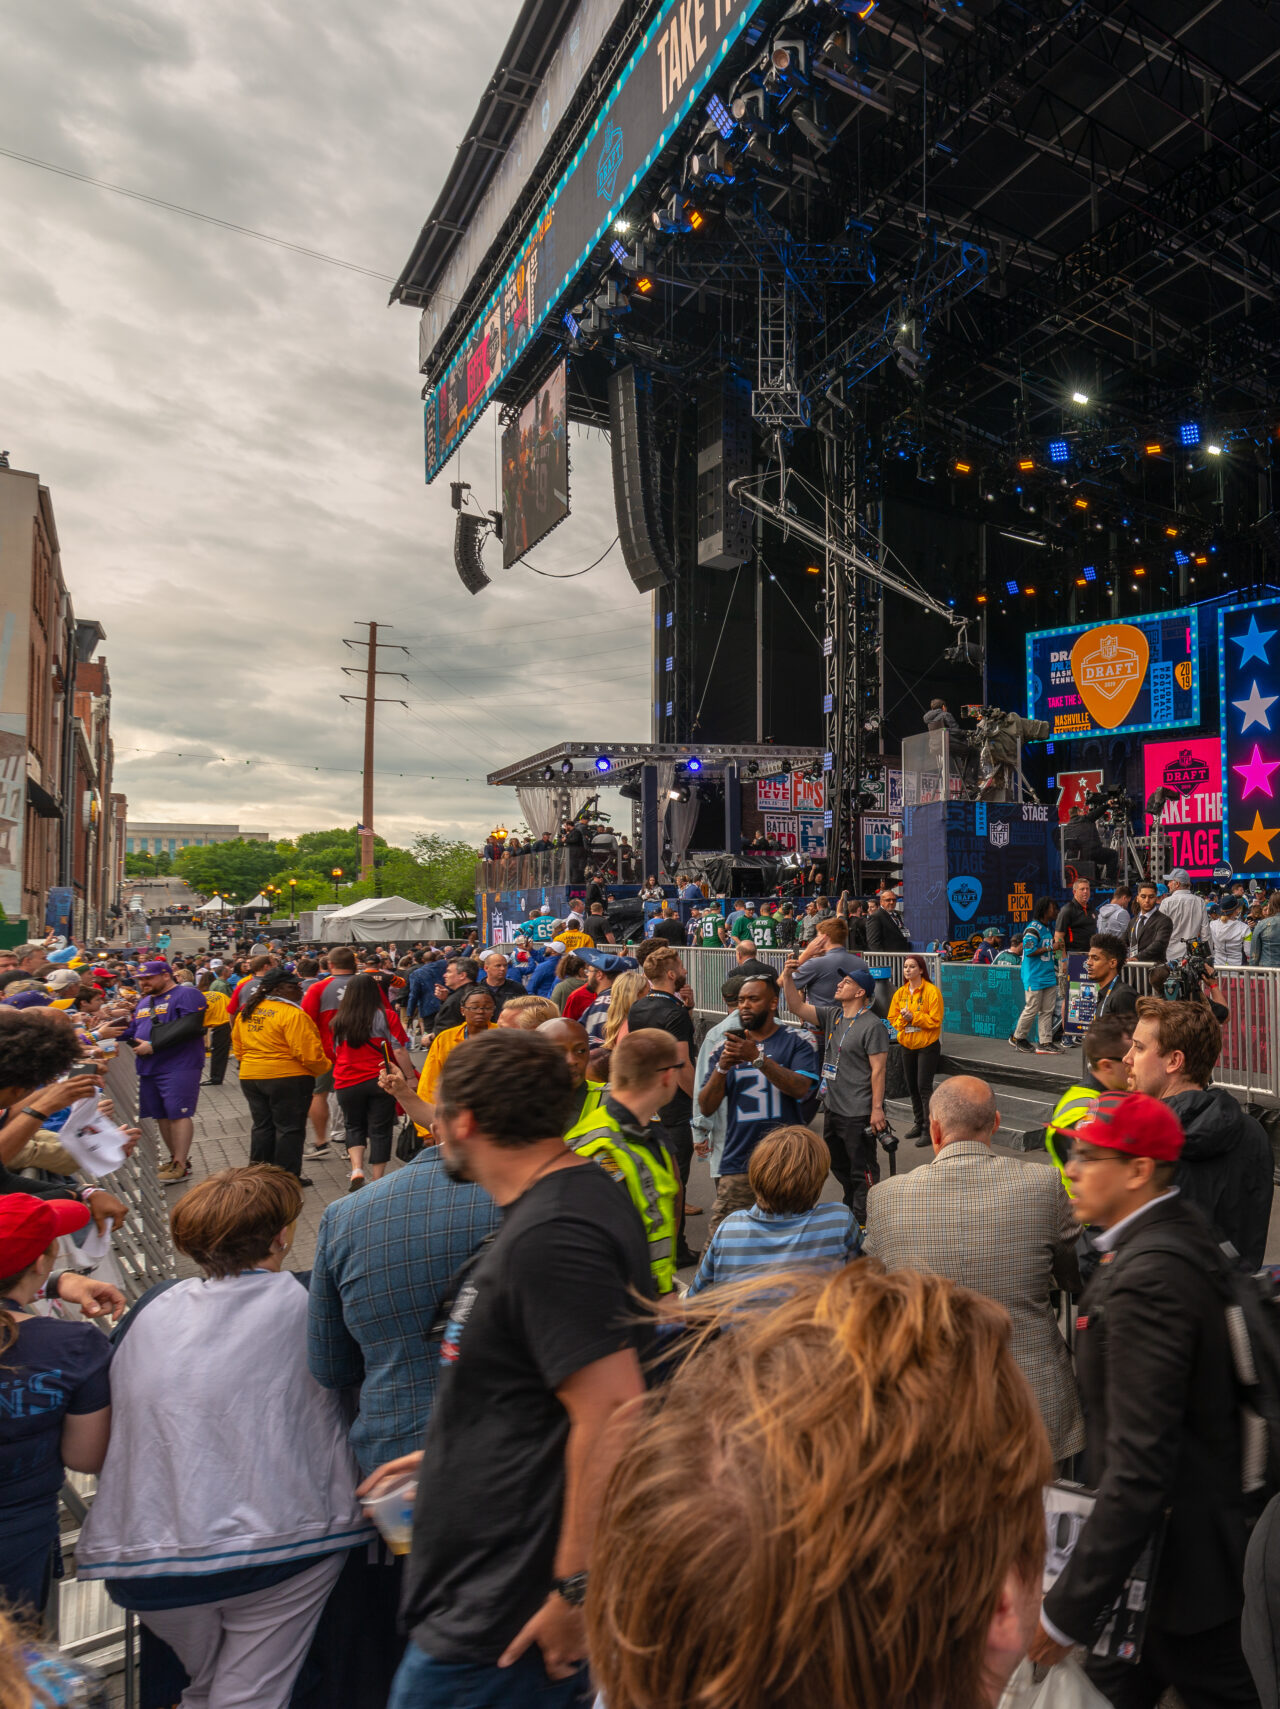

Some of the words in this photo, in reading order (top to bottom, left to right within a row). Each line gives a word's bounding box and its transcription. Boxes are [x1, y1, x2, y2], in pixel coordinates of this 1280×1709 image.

[657, 0, 707, 114] TAKE
[1086, 662, 1134, 679] DRAFT
[1152, 669, 1160, 709] LEAGUE
[1048, 697, 1064, 708] TAKE
[1065, 695, 1076, 706] THE
[1055, 712, 1089, 727] NASHVILLE
[1166, 770, 1206, 782] DRAFT
[758, 790, 790, 800] IEVE
[793, 779, 823, 808] FINS
[1022, 805, 1049, 822] STAGE
[1158, 792, 1191, 824] AKE
[766, 821, 797, 833] BATTLE
[865, 823, 891, 835] TITAN
[992, 832, 1008, 844] NFL
[864, 834, 891, 860] UP
[1170, 829, 1221, 867] TAGE
[1014, 882, 1026, 893] THE
[1010, 895, 1029, 910] PICK
[1014, 911, 1020, 922] IS
[1021, 911, 1028, 922] IN
[754, 928, 773, 946] 24
[734, 1066, 783, 1123] 31
